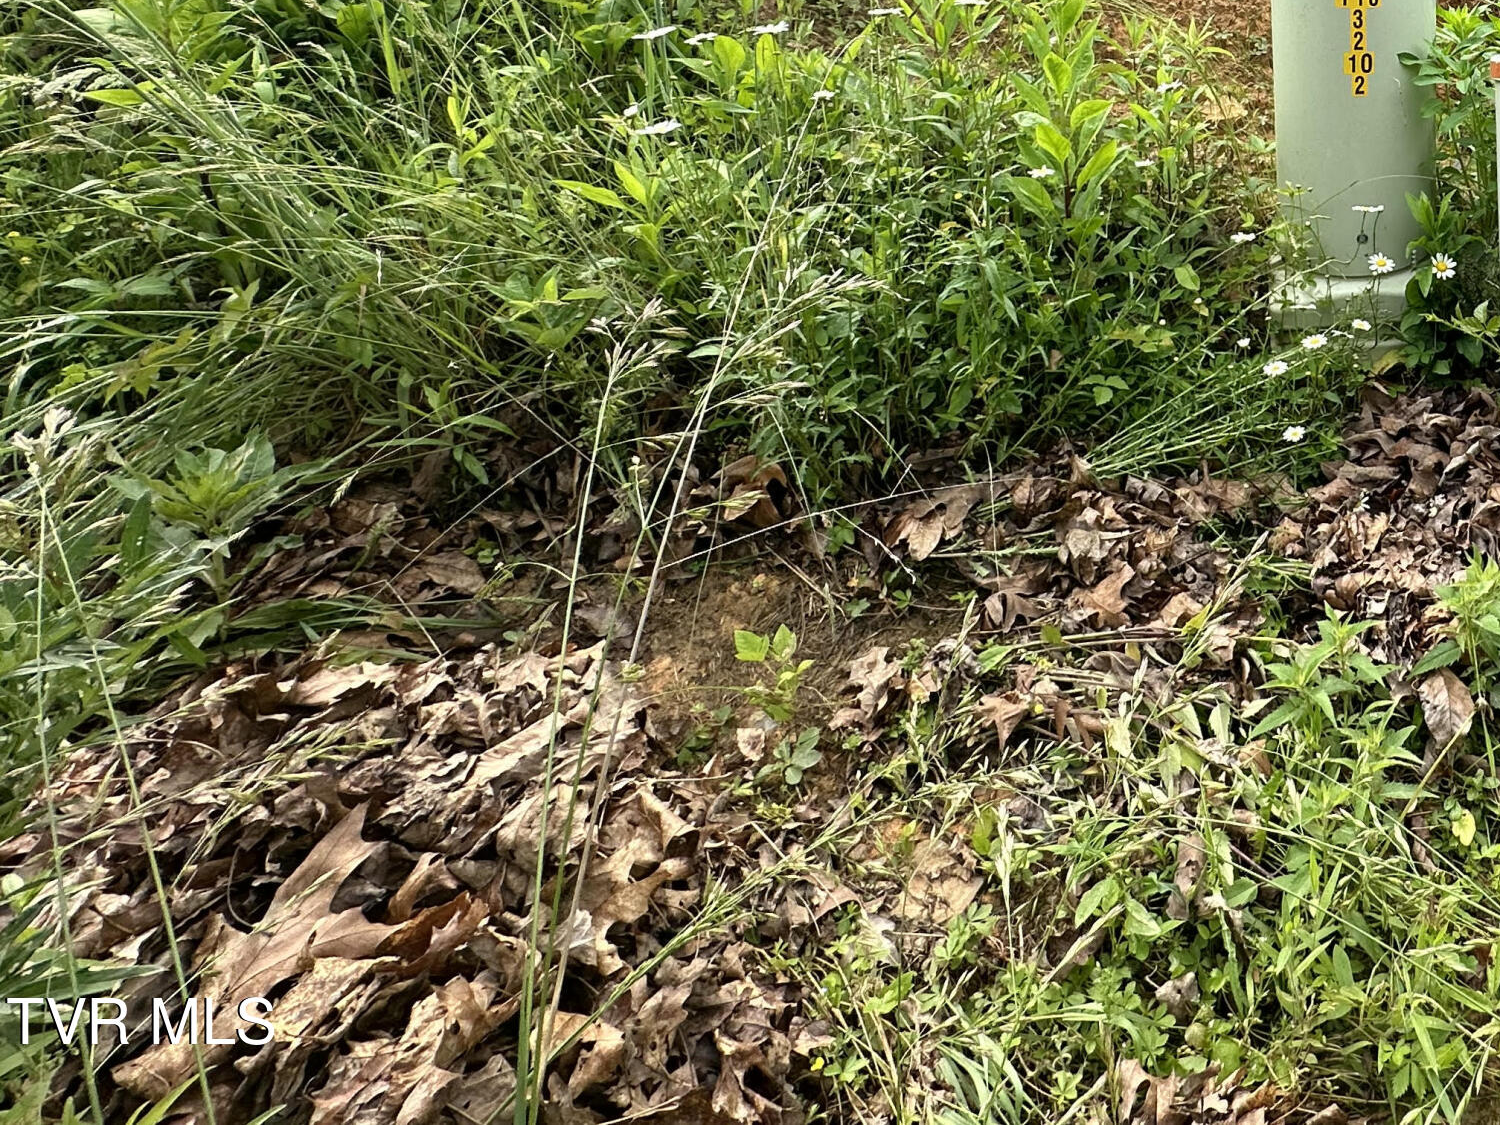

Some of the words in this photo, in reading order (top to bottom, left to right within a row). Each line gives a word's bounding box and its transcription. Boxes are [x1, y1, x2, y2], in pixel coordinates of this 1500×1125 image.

[1353, 9, 1363, 29] 3
[1353, 31, 1364, 50] 2
[1348, 53, 1372, 73] 10
[1355, 76, 1366, 95] 2
